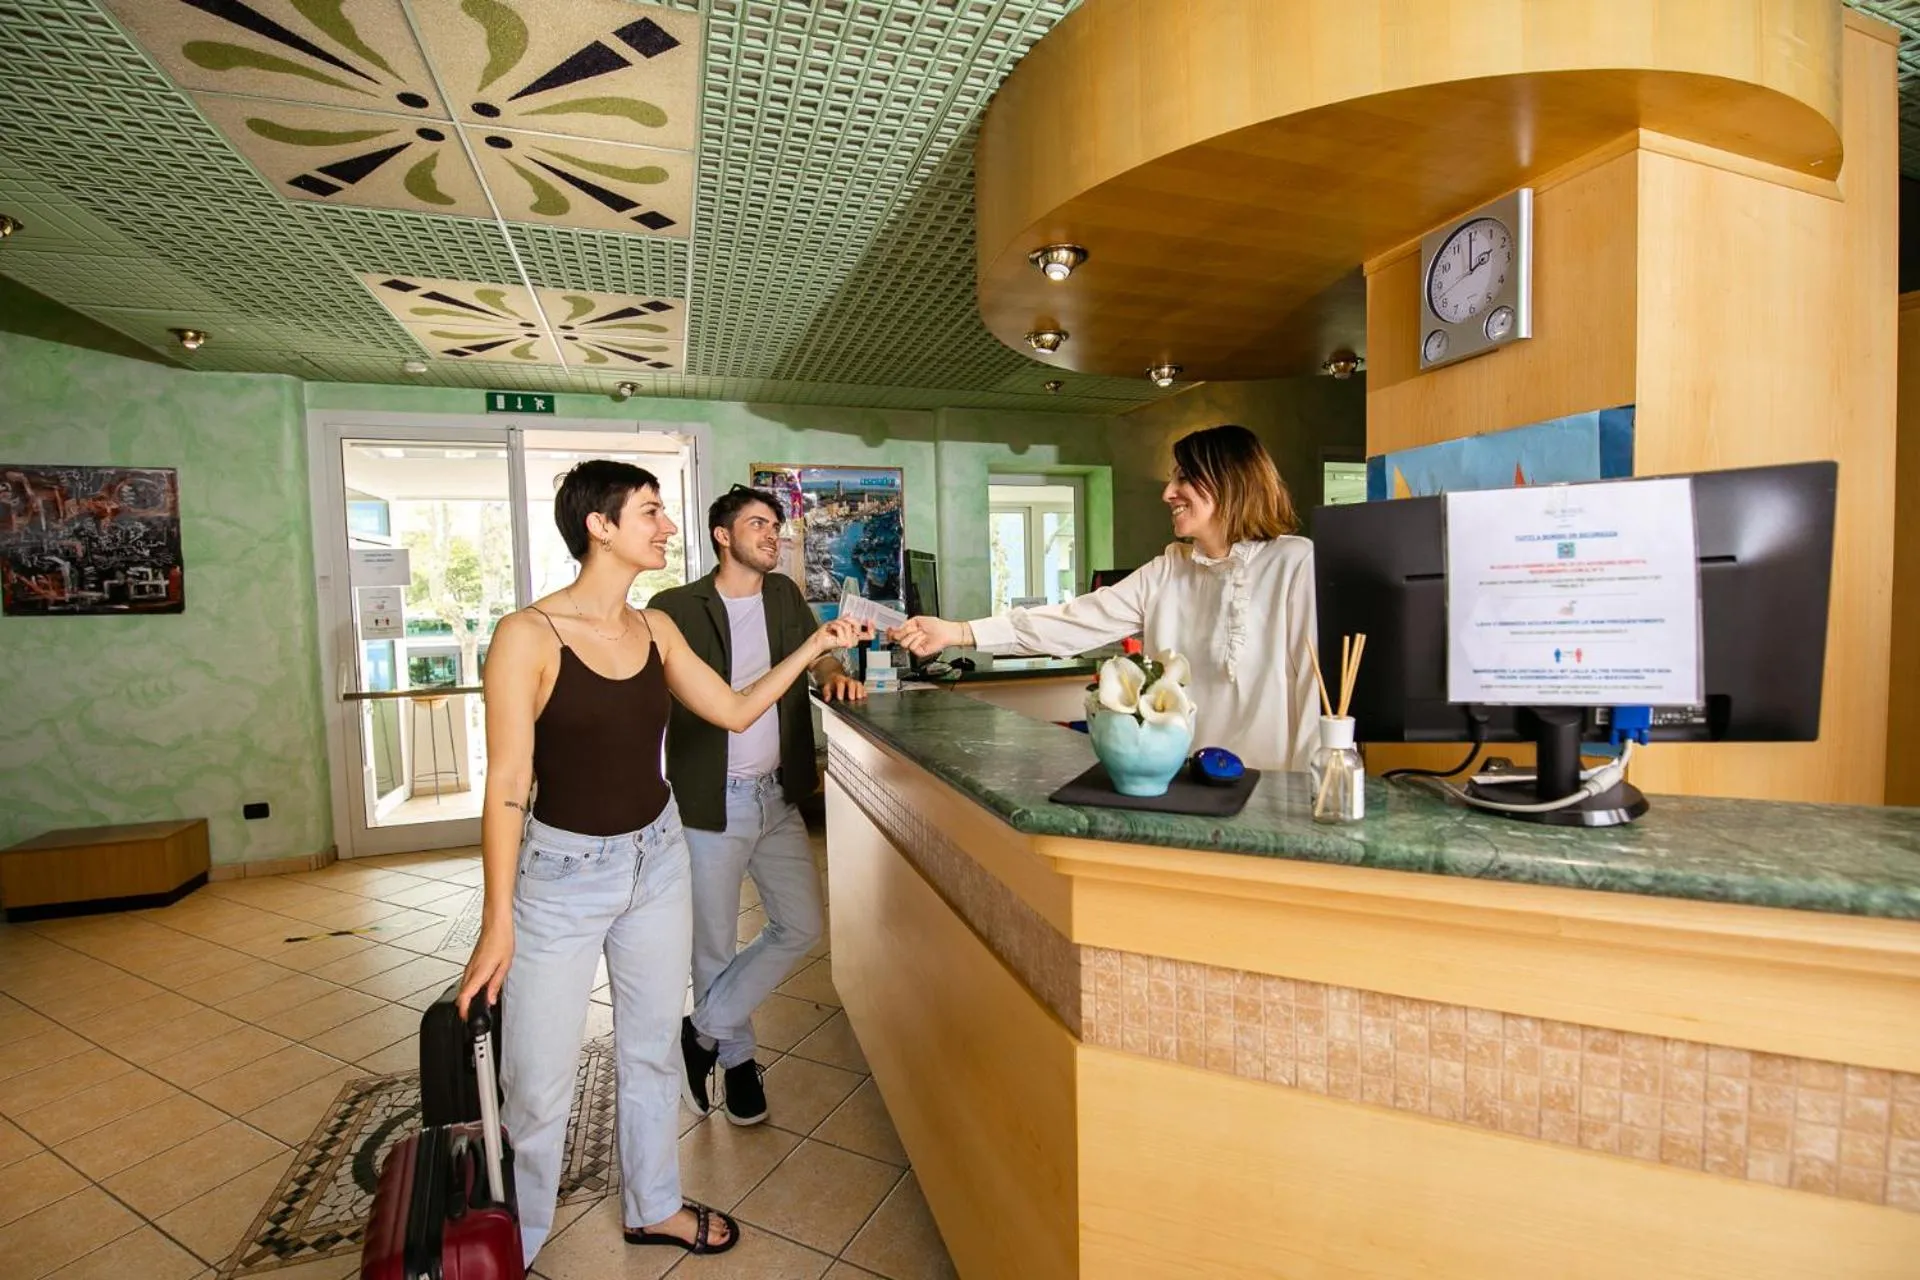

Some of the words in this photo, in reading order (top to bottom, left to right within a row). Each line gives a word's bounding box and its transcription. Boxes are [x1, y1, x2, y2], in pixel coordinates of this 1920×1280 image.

[1500, 236, 1506, 249] 2
[1453, 244, 1460, 255] 11
[1442, 262, 1451, 274] 10
[1498, 275, 1505, 285] 4
[1442, 298, 1448, 308] 8
[1453, 304, 1459, 315] 7
[1469, 304, 1475, 314] 6
